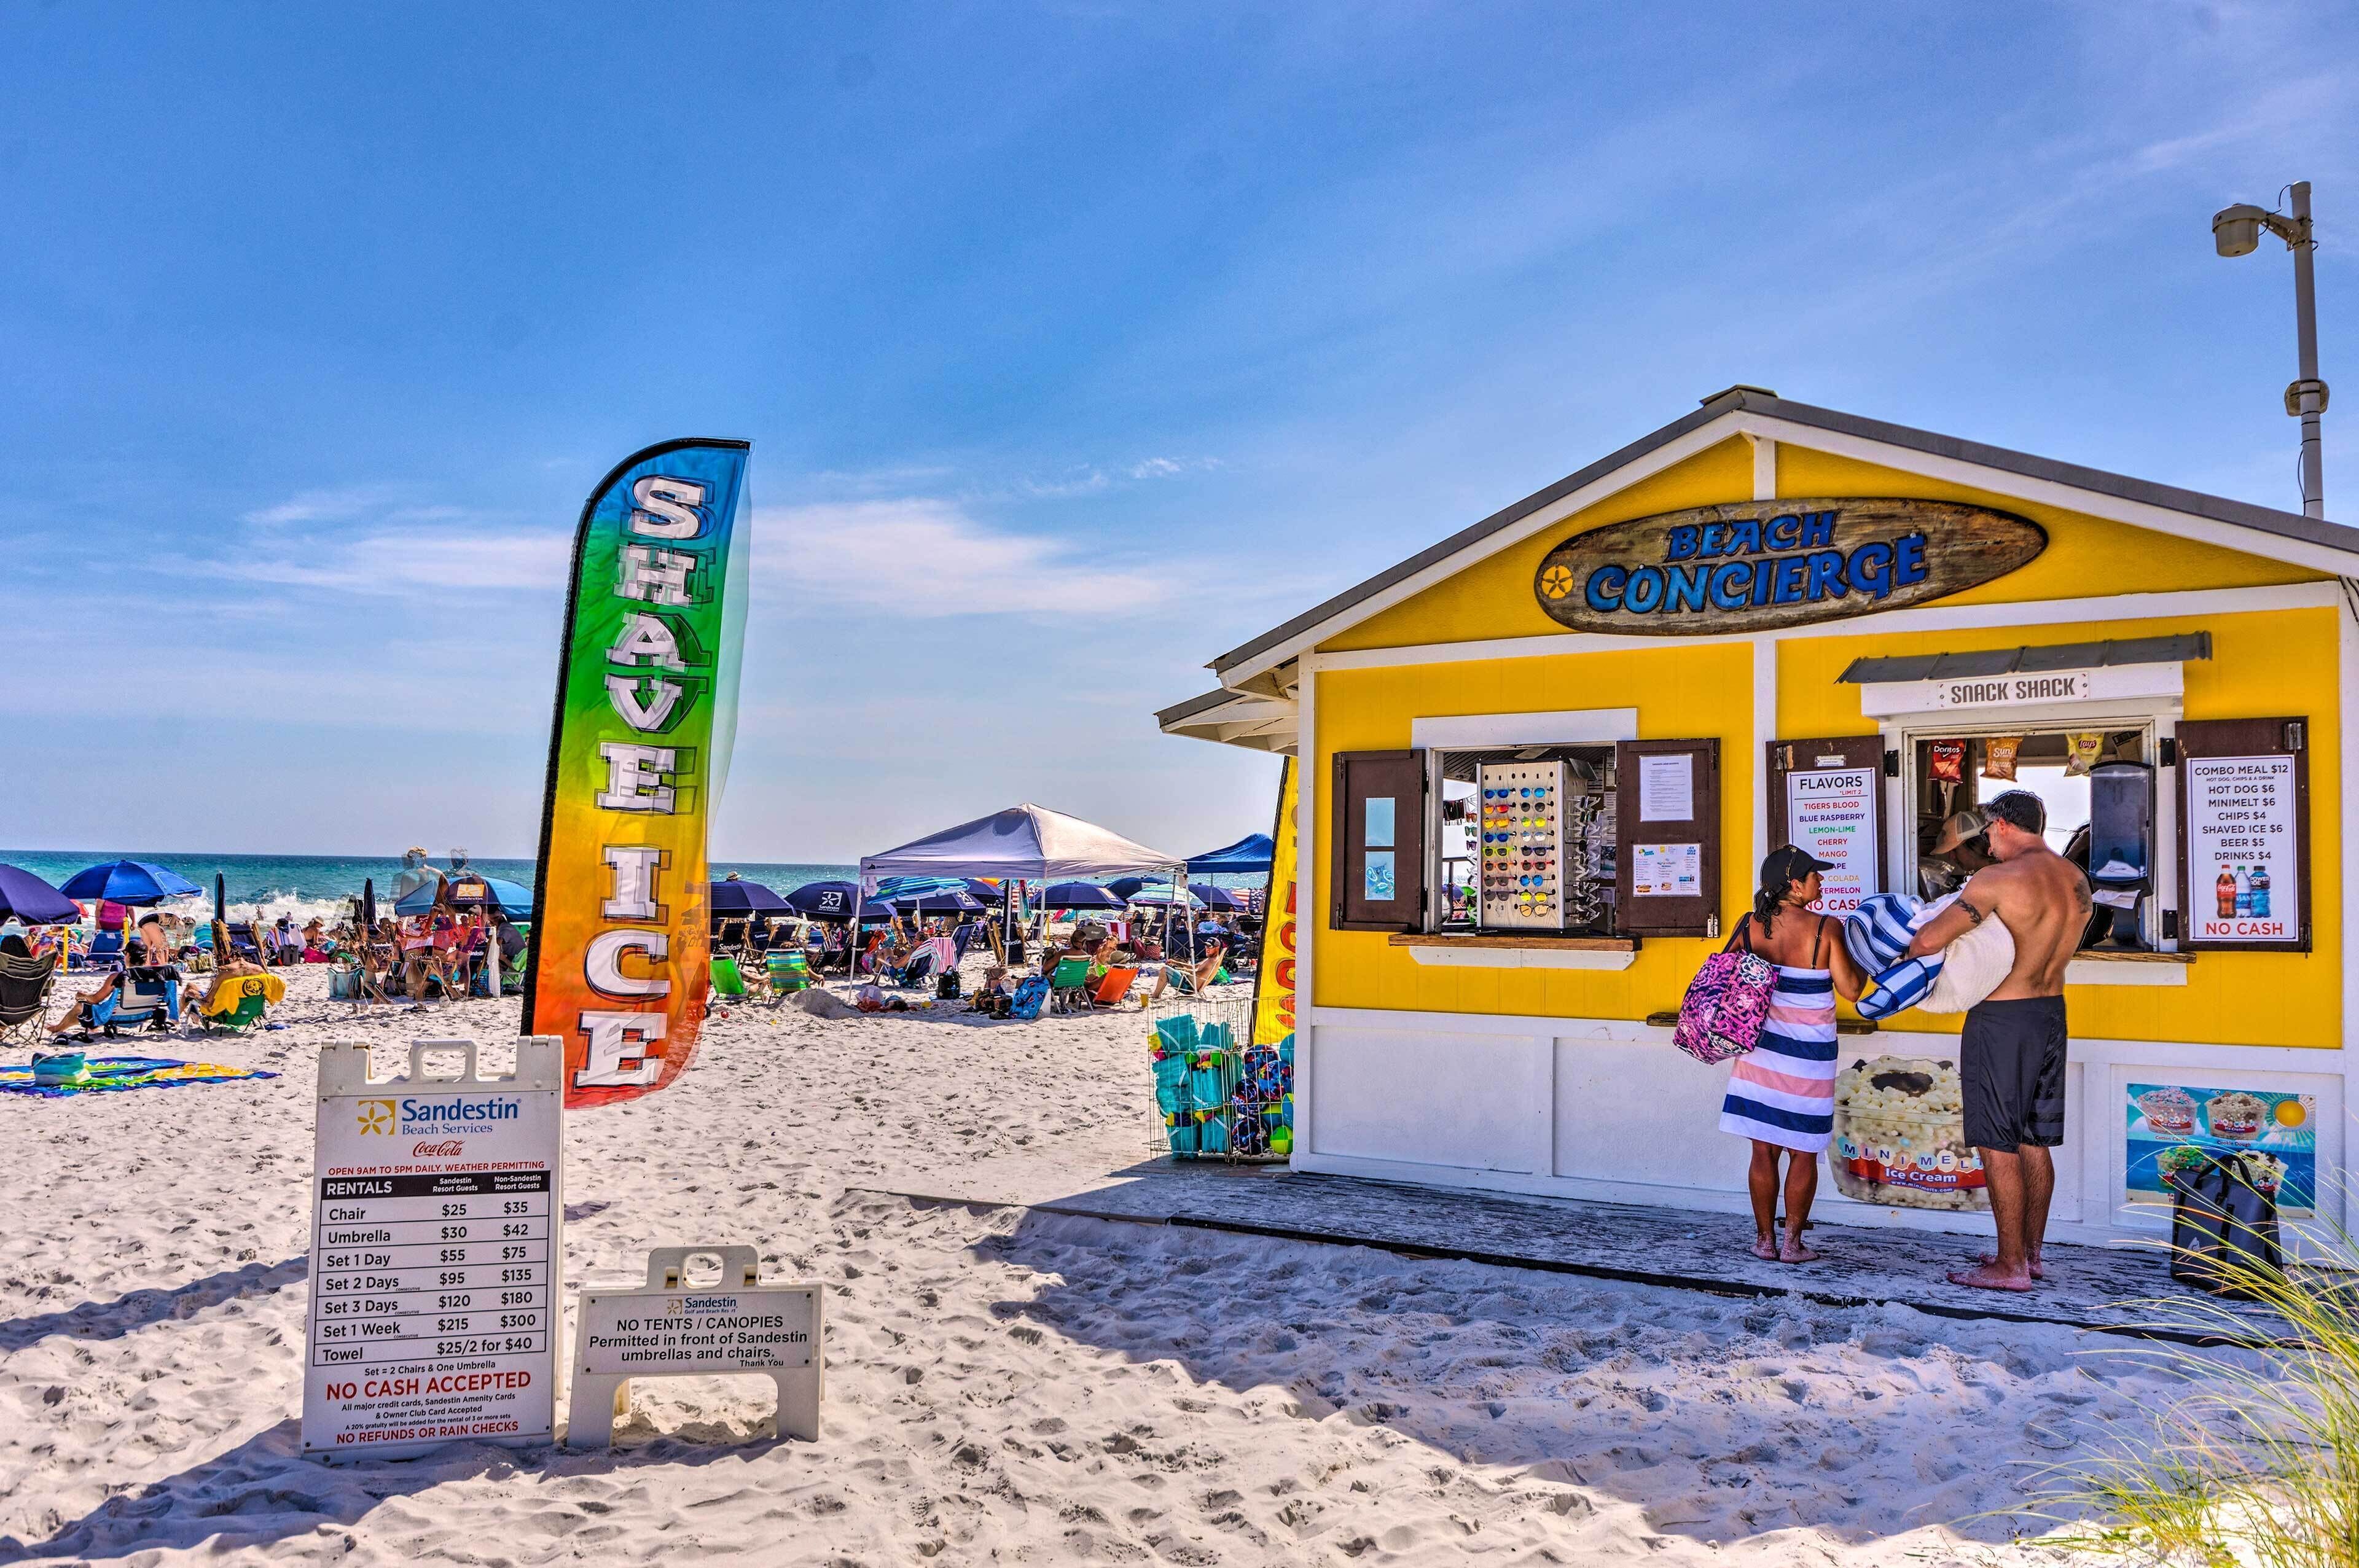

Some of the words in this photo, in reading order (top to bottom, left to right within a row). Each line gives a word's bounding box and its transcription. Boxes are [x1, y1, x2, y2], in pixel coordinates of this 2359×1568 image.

[1664, 510, 1839, 561] BEACH
[1585, 532, 1928, 613] CONCIERGE
[595, 474, 710, 816] SHAVE
[1951, 682, 2008, 703] SNACK
[2016, 678, 2075, 699] SHACK
[2195, 766, 2234, 775] COMBO
[2271, 765, 2288, 773] $12
[1801, 776, 1862, 790] FLAVORS
[2235, 785, 2258, 794] DOG
[2209, 798, 2259, 807] MINIMELT
[2263, 798, 2275, 806] $6
[2253, 811, 2266, 820] $4
[2270, 824, 2282, 833] $6
[2252, 838, 2264, 847] $5
[2259, 851, 2271, 860] $4
[2207, 922, 2231, 935] NO
[2237, 922, 2282, 935] CASH
[571, 843, 676, 1093] ICE
[403, 1124, 438, 1134] Beach
[443, 1123, 493, 1134] Services
[491, 1161, 544, 1169] PERMITTING
[1886, 1168, 1906, 1179] Ice
[1910, 1172, 1957, 1182] Cream
[327, 1181, 392, 1195] RENTALS
[1892, 1180, 1952, 1193] www.minimelts.com
[329, 1207, 366, 1220] Chair
[442, 1204, 466, 1217] $25
[504, 1201, 528, 1215] $35
[329, 1230, 390, 1243] Umbrella
[441, 1227, 467, 1240] $30
[503, 1224, 528, 1237] $42
[327, 1255, 350, 1267] Set
[354, 1254, 359, 1265] 1
[365, 1254, 390, 1266] Day
[440, 1249, 465, 1263] $55
[503, 1247, 526, 1260] $75
[326, 1279, 348, 1290] Set
[353, 1277, 361, 1289] 2
[367, 1277, 399, 1289] Days
[440, 1273, 464, 1286] $95
[502, 1269, 531, 1282] $135
[325, 1302, 347, 1314] Set
[353, 1301, 360, 1312] 3
[366, 1300, 398, 1312] Days
[439, 1295, 470, 1309] $120
[501, 1292, 532, 1306] $180
[686, 1297, 737, 1308] Sandestin
[324, 1325, 346, 1337] Set
[351, 1324, 356, 1336] 1
[362, 1322, 400, 1335] Week
[438, 1318, 468, 1332] $215
[501, 1314, 536, 1328] $300
[617, 1319, 639, 1332] NO
[644, 1318, 692, 1330] TENTS
[697, 1317, 702, 1329] /
[706, 1316, 783, 1328] CANOPIES
[590, 1335, 659, 1348] Permitted
[664, 1334, 675, 1346] in
[681, 1333, 714, 1345] front
[719, 1332, 734, 1344] of
[738, 1331, 807, 1343] Sandestin
[323, 1347, 362, 1361] Towel
[437, 1340, 477, 1355] $25/2
[482, 1340, 501, 1351] for
[506, 1338, 532, 1351] $40
[622, 1348, 691, 1361] umbrellas
[697, 1347, 722, 1359] and
[728, 1346, 774, 1359] chairs.
[398, 1365, 425, 1373] Chairs
[457, 1360, 495, 1370] Umbrella
[327, 1383, 357, 1400] NO
[365, 1378, 418, 1397] CASH
[426, 1371, 531, 1394] ACCEPTED
[426, 1397, 460, 1405] Sandestin
[448, 1405, 482, 1414] Accepted
[337, 1433, 354, 1444] NO
[359, 1429, 415, 1442] REFUNDS
[419, 1427, 436, 1438] OR
[440, 1425, 467, 1436] RAIN
[472, 1421, 518, 1433] CHECKS
